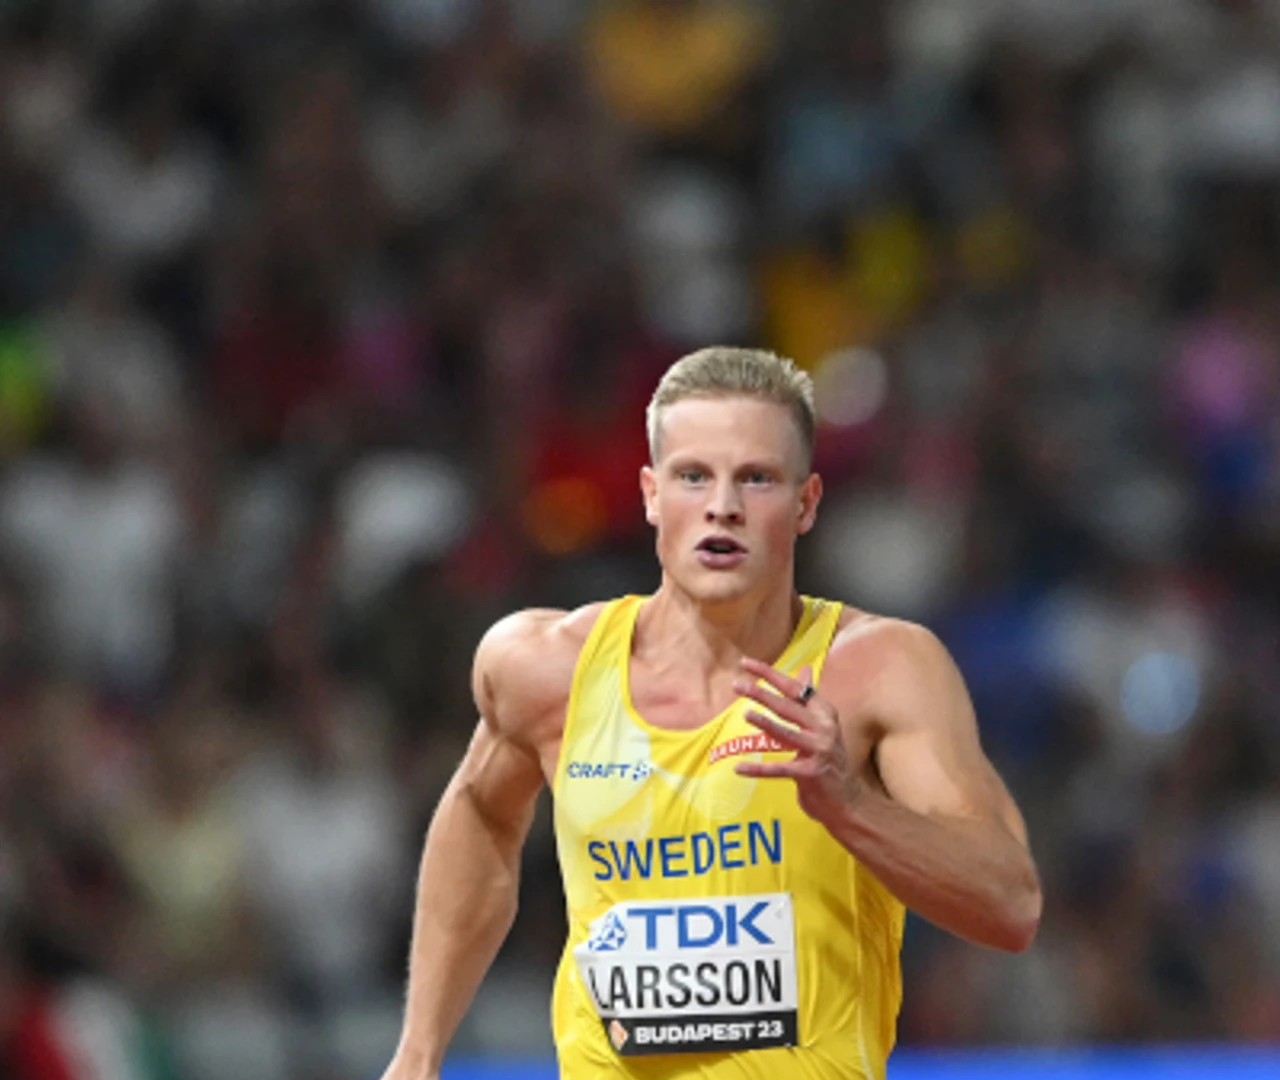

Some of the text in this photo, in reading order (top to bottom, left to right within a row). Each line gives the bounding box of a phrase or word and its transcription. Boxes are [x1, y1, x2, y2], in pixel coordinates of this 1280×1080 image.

[567, 762, 631, 779] CRAFT
[588, 819, 783, 881] SWEDEN
[627, 902, 775, 950] TDK
[588, 958, 782, 1010] LARSSON
[634, 1020, 784, 1045] BUDAPEST 23
